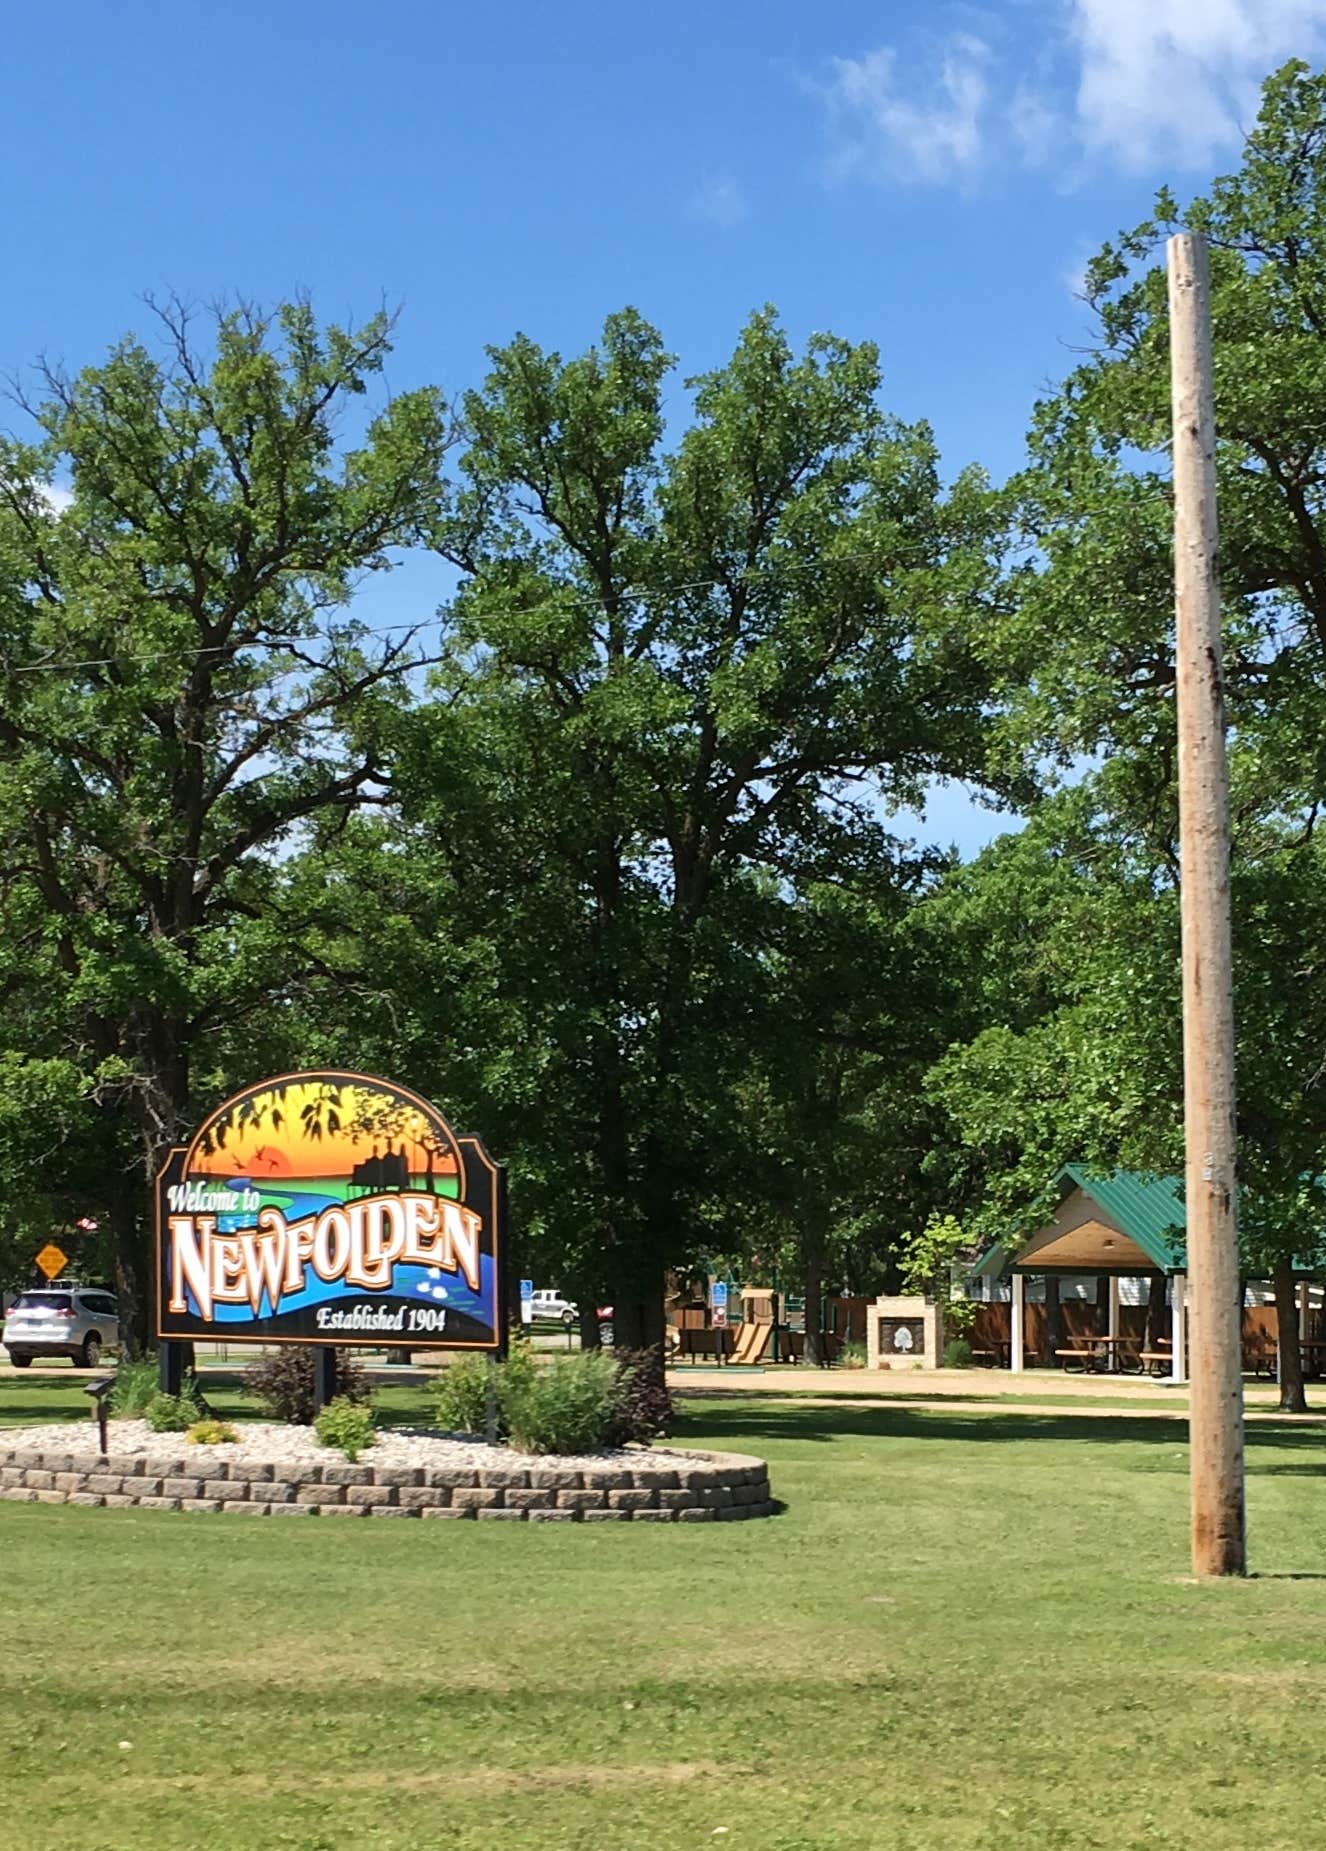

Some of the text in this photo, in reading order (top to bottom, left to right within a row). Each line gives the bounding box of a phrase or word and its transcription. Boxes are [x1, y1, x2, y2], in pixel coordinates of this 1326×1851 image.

[167, 1181, 260, 1213] Welcome to
[168, 1193, 482, 1322] NEWFOLDEN
[316, 1304, 446, 1331] Established 1904
